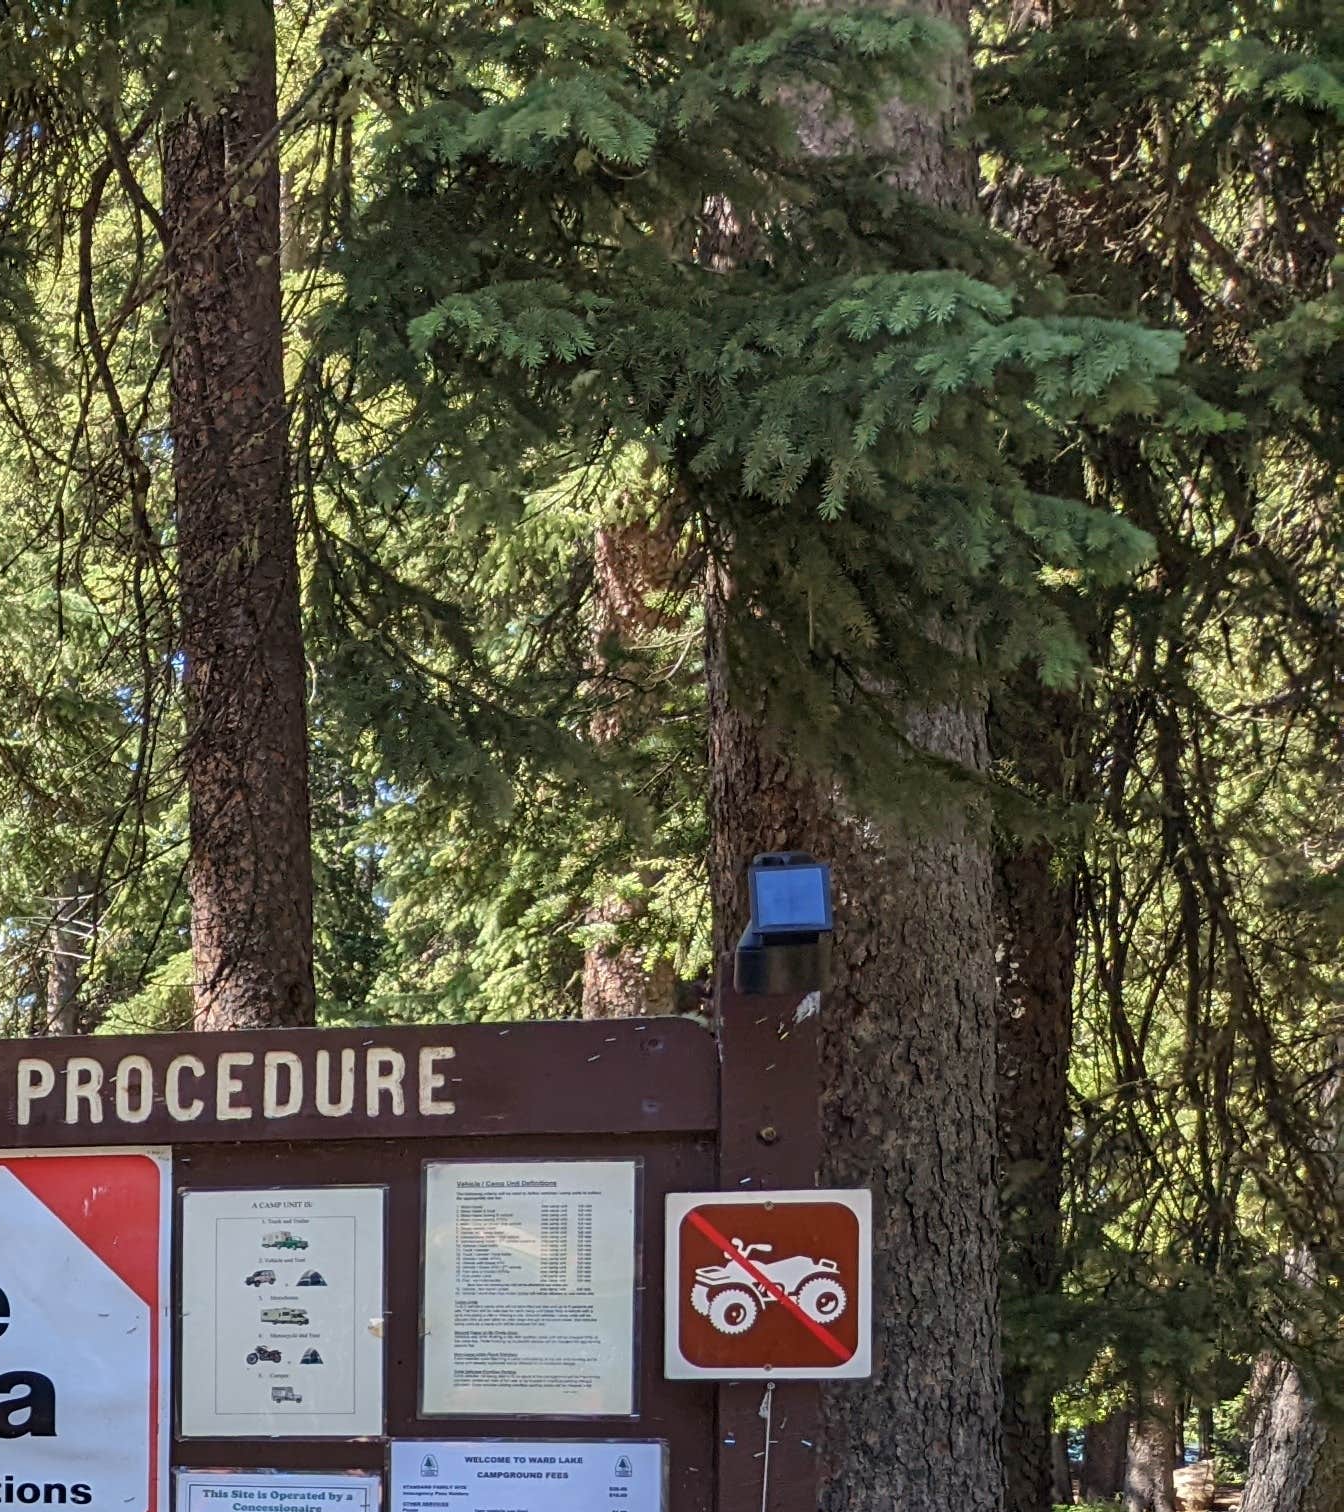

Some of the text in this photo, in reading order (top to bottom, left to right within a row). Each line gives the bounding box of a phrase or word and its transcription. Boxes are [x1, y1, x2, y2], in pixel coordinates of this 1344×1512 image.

[17, 1046, 456, 1125] PROCEDURE
[259, 1201, 282, 1209] CAMP
[465, 1456, 511, 1464] WELCOME
[513, 1456, 526, 1464] TO
[477, 1471, 543, 1479] CAMPGROUND
[203, 1489, 352, 1502] This Site is Operated by a
[233, 1503, 322, 1512] Concessionaire
